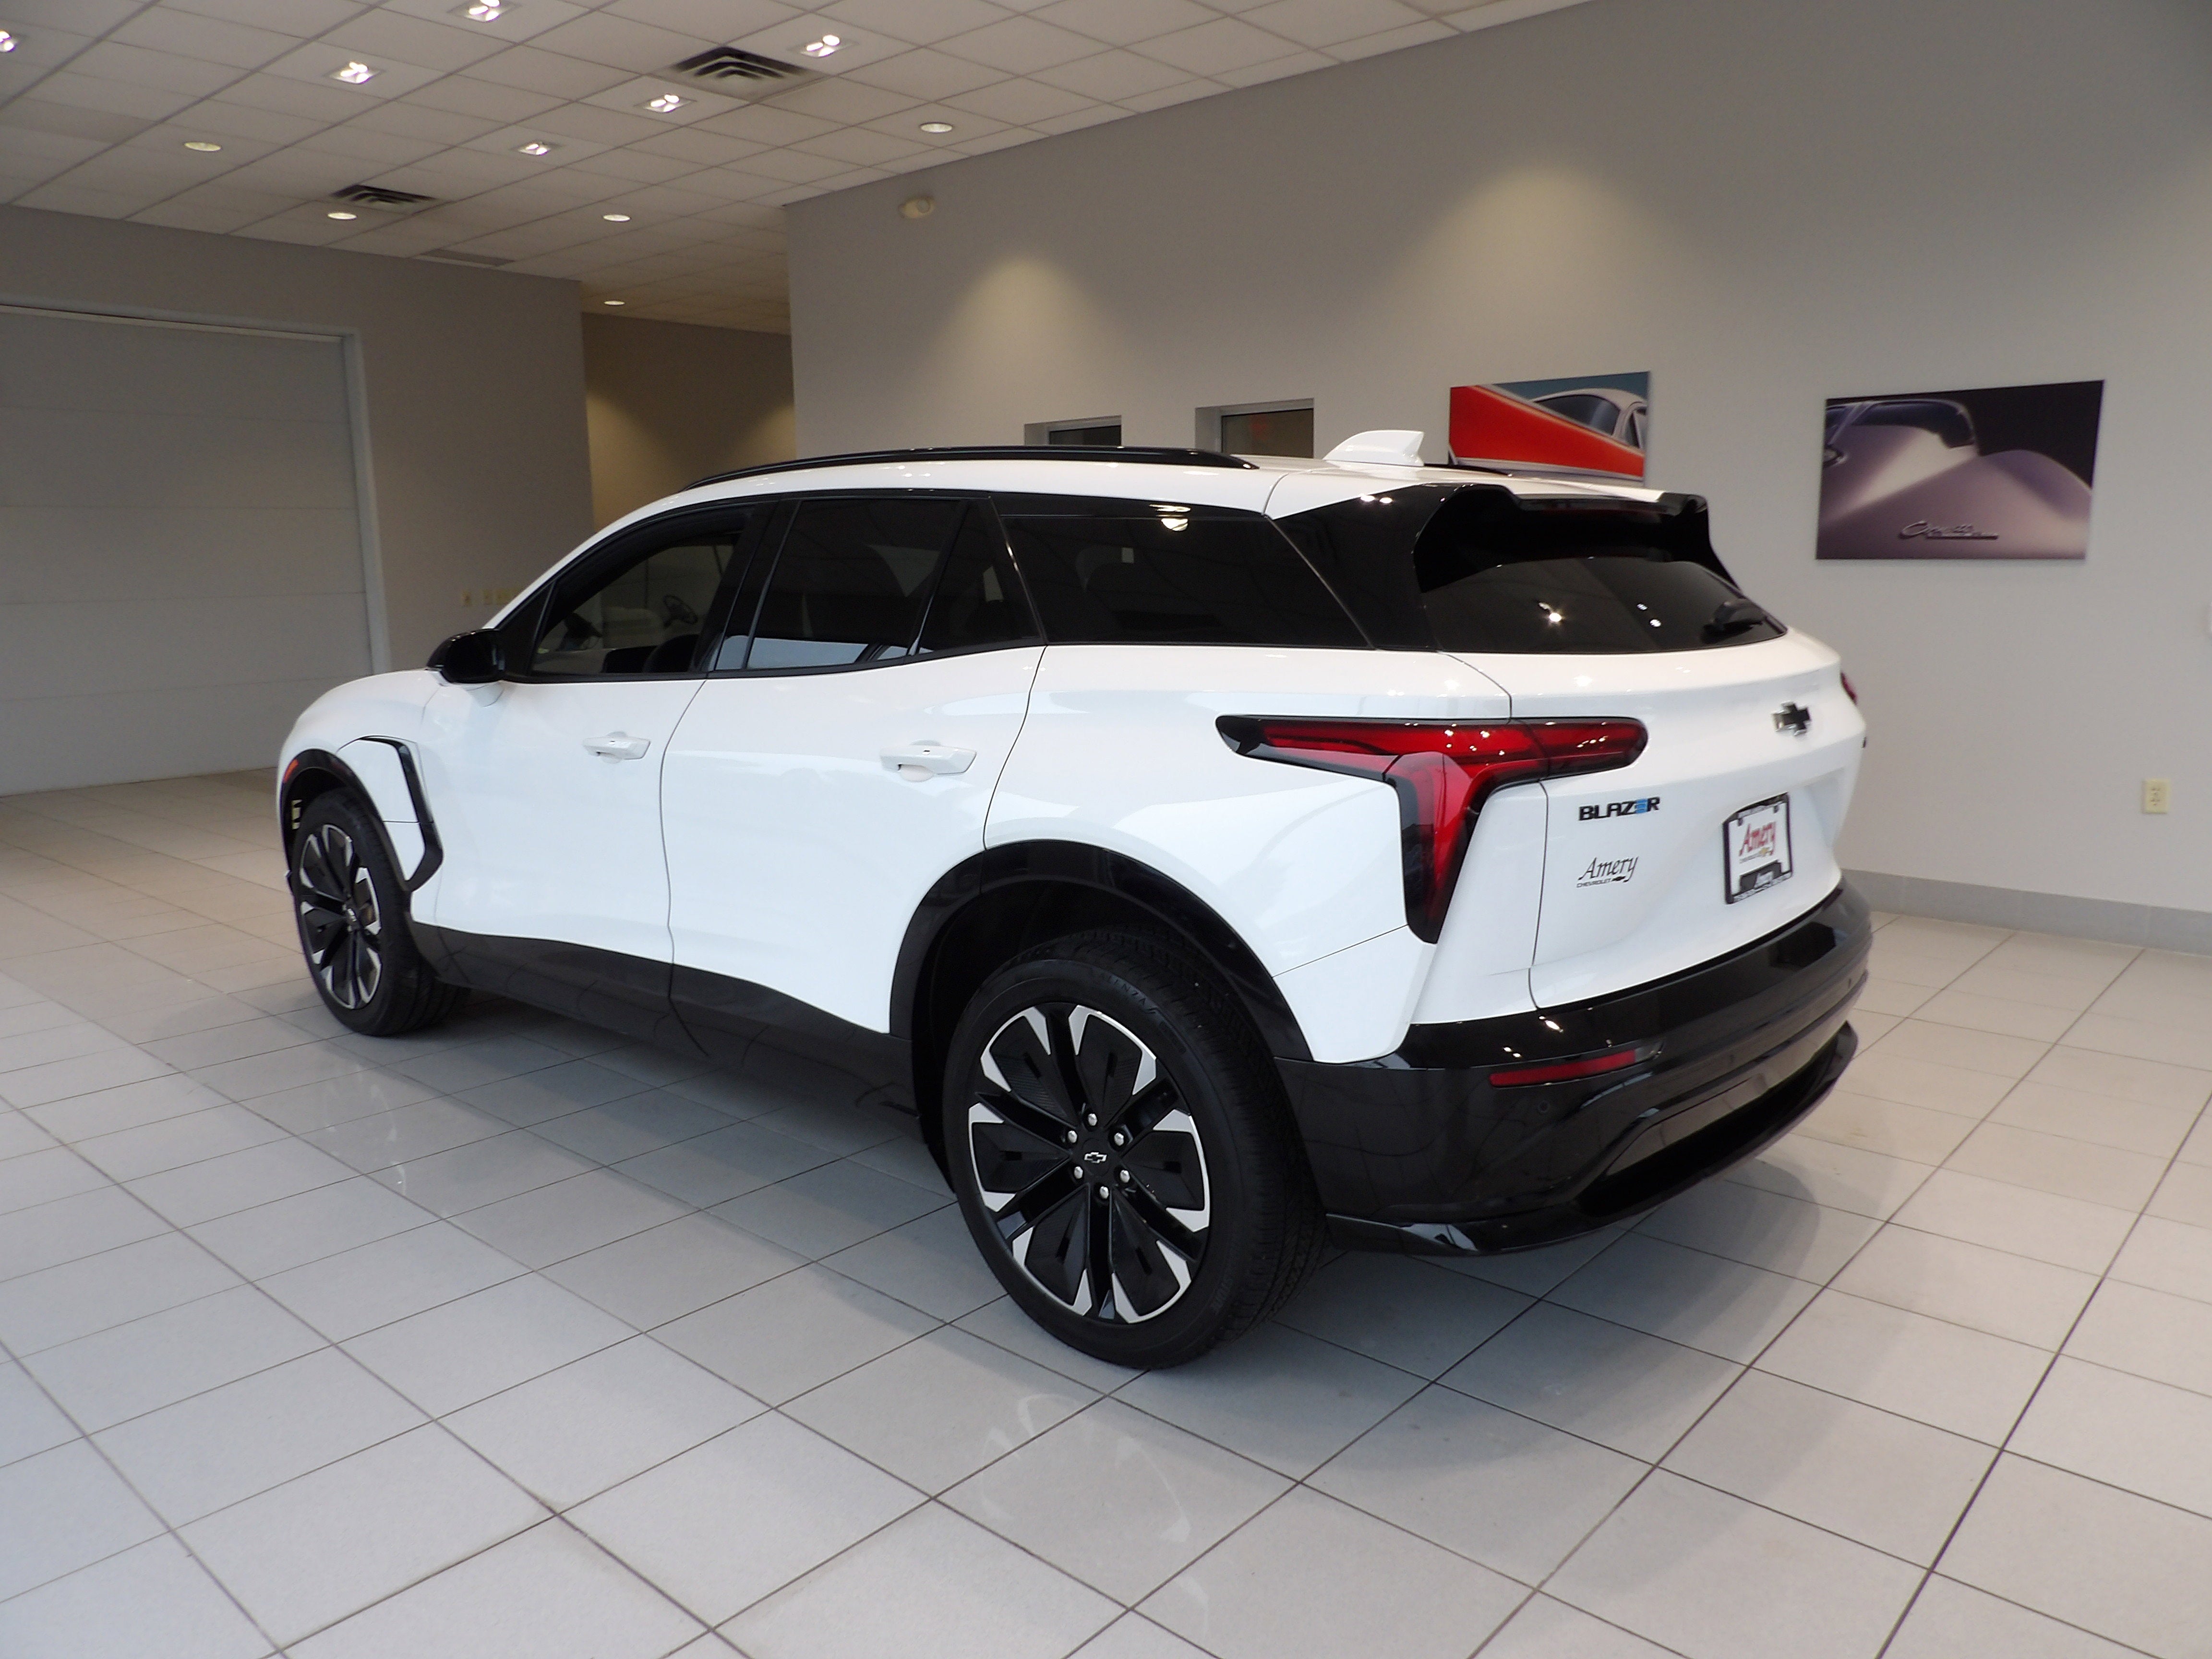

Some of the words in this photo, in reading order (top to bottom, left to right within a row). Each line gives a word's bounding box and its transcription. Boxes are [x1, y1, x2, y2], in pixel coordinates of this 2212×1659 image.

[1578, 796, 1660, 820] BLAZER
[1739, 821, 1776, 856] Amery
[1577, 857, 1638, 882] Amery
